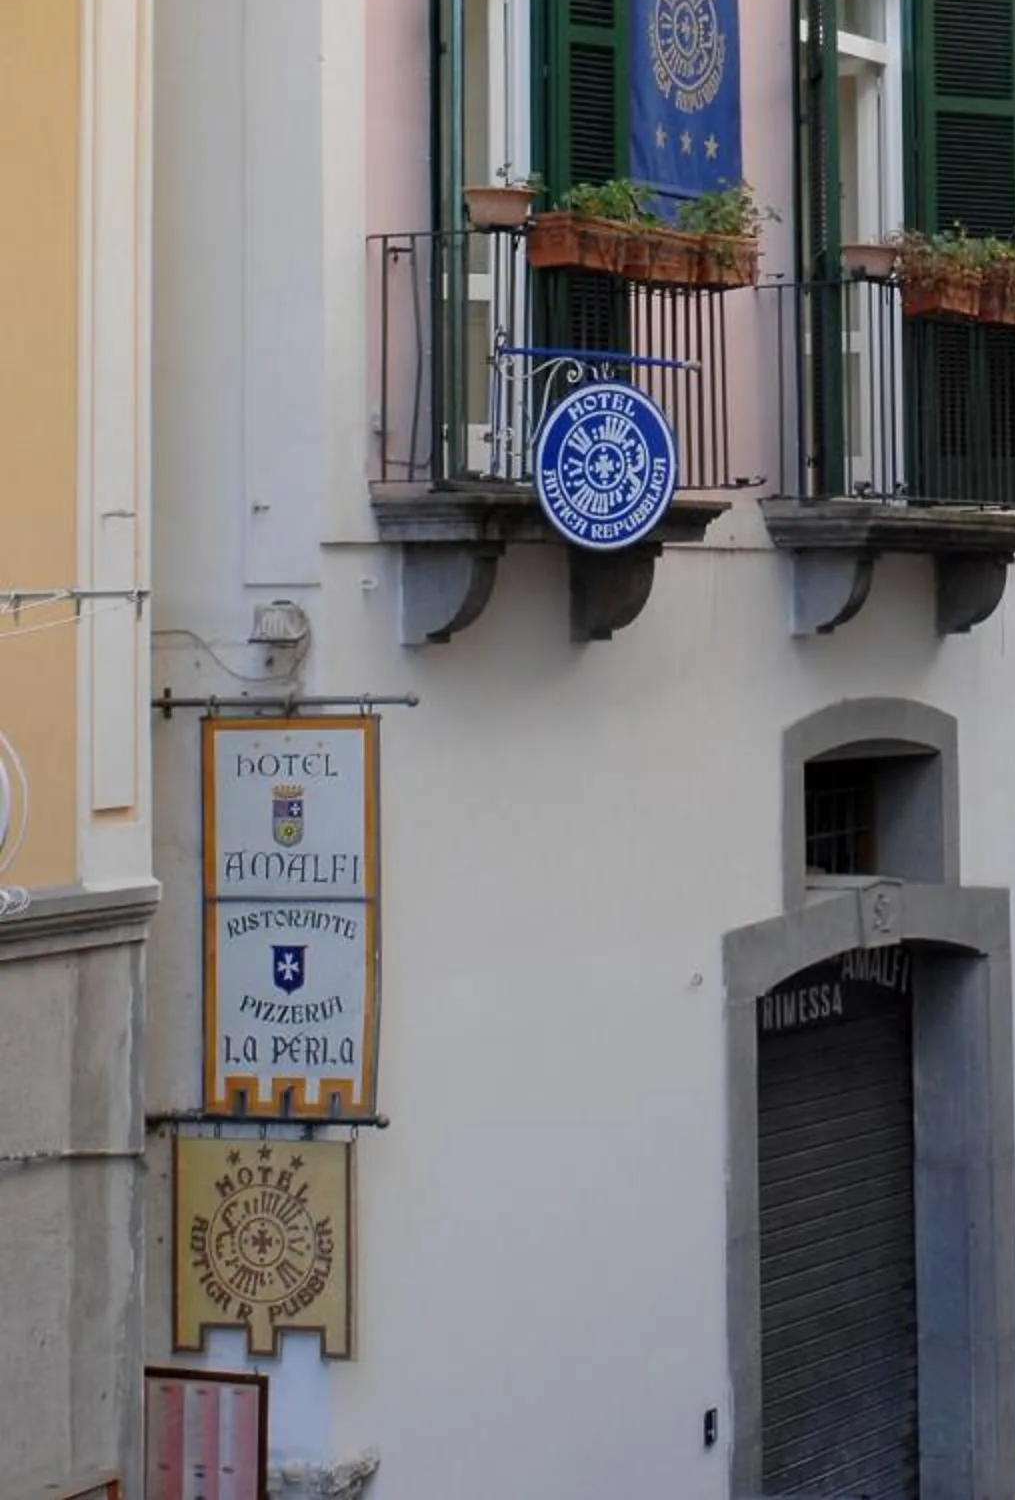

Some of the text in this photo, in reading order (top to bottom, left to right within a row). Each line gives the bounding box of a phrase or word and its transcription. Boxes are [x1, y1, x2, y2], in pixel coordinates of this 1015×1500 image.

[566, 392, 636, 421] HOTEL
[543, 456, 667, 539] ANTICA REPUBBLICA
[223, 851, 358, 884] AMALFI
[227, 909, 358, 940] RISTORANTE
[763, 948, 910, 1030] RIMESSA AMALFI
[239, 995, 344, 1025] PIZZERIA
[215, 1166, 308, 1206] HOTEL
